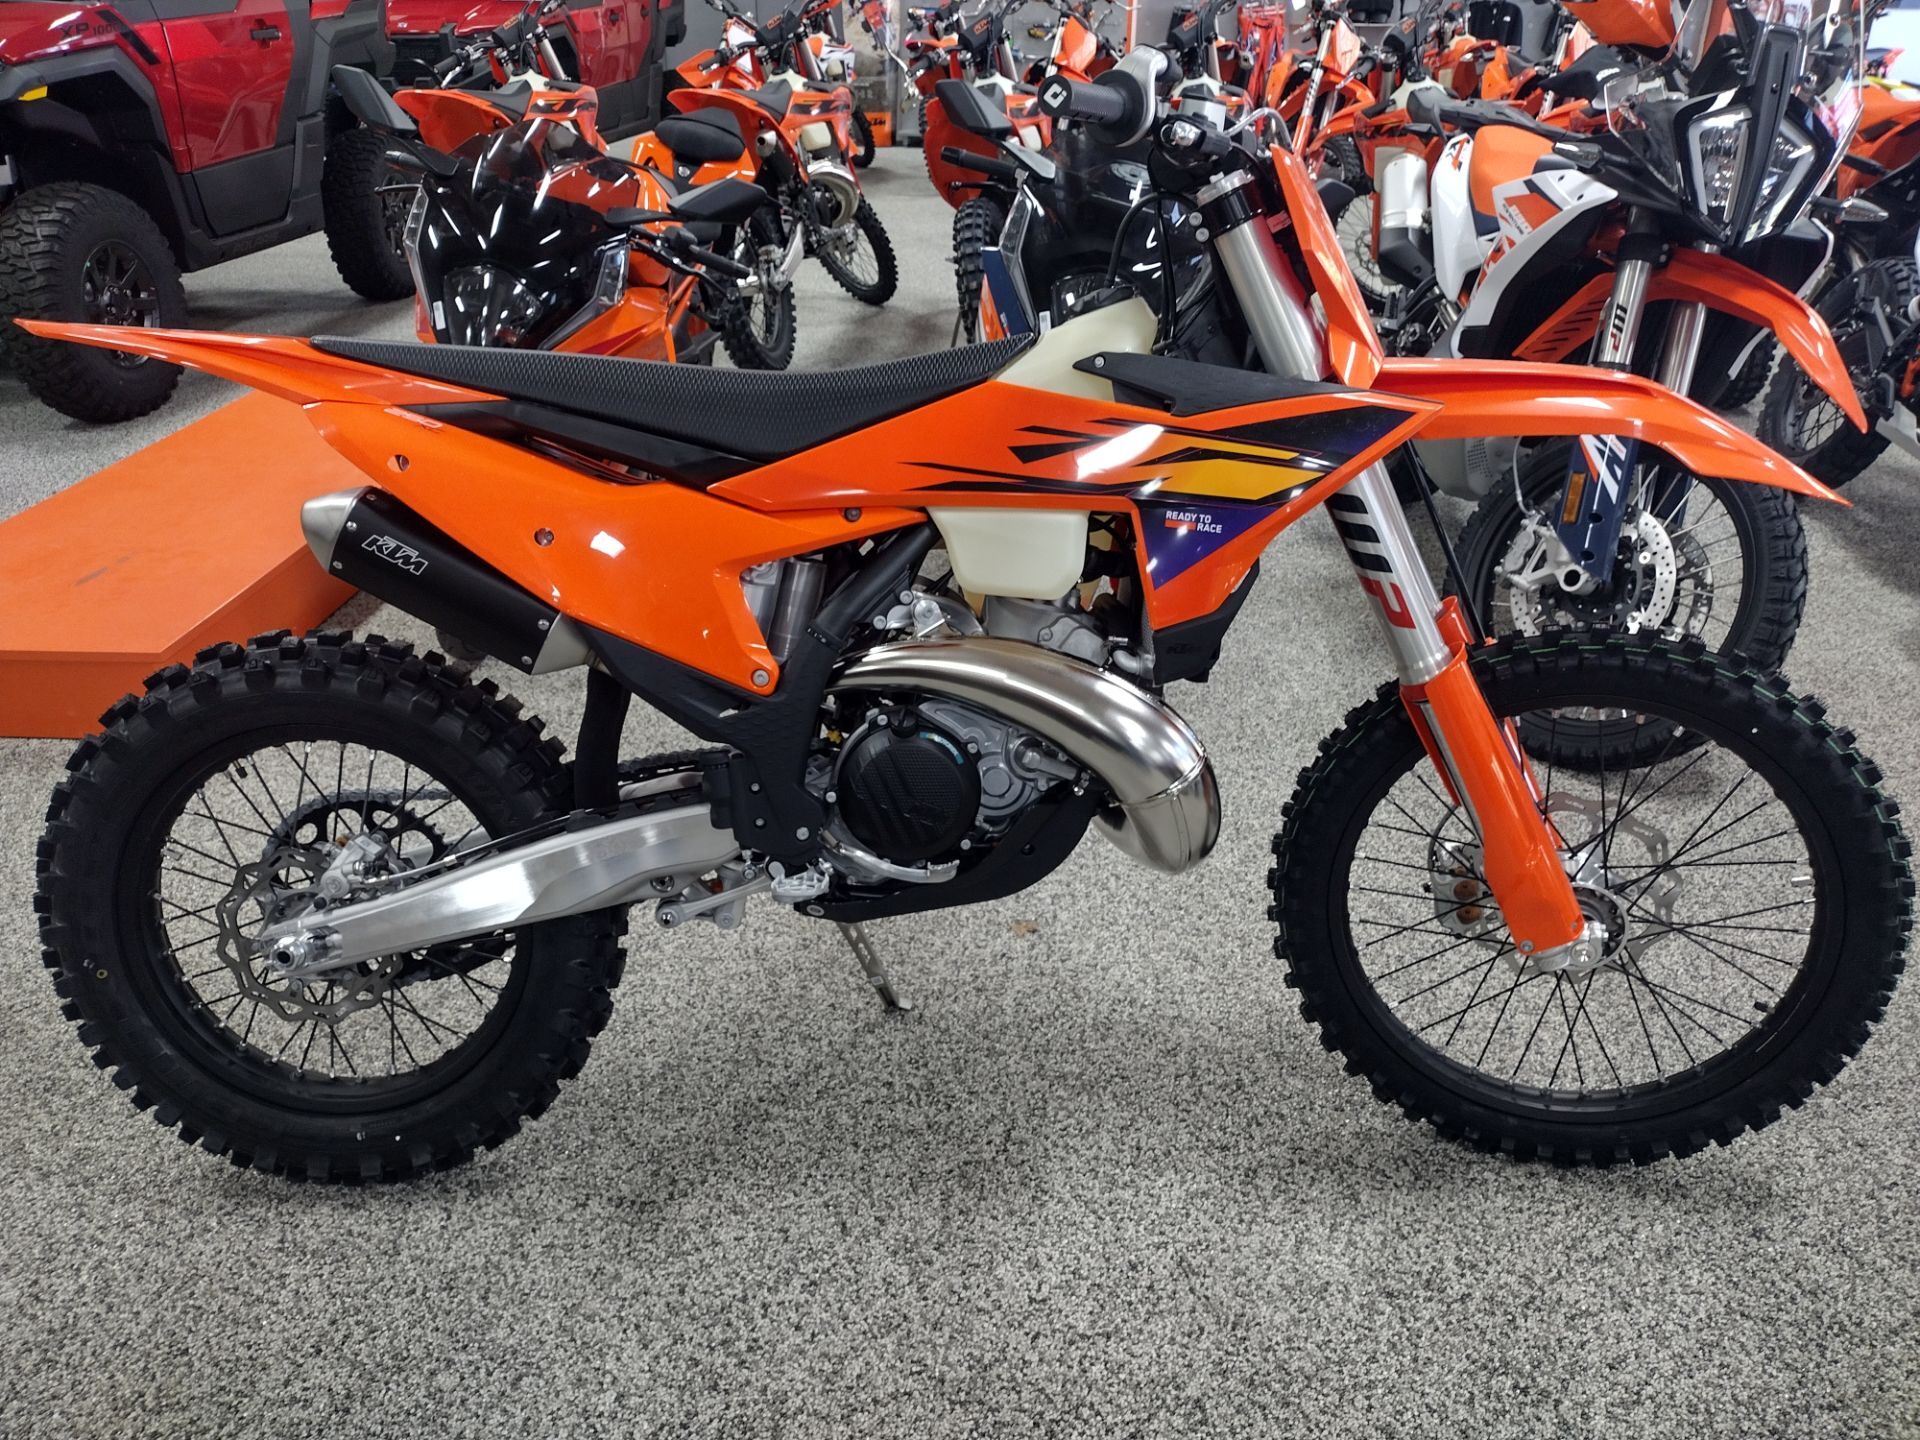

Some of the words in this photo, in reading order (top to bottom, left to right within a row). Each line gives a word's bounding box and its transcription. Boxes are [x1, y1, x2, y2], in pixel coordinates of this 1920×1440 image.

[61, 22, 89, 39] XP
[1165, 510, 1197, 522] READY
[1199, 513, 1212, 524] TO
[1196, 522, 1223, 534] RACE
[361, 534, 429, 576] KTM
[1323, 493, 1417, 630] WP
